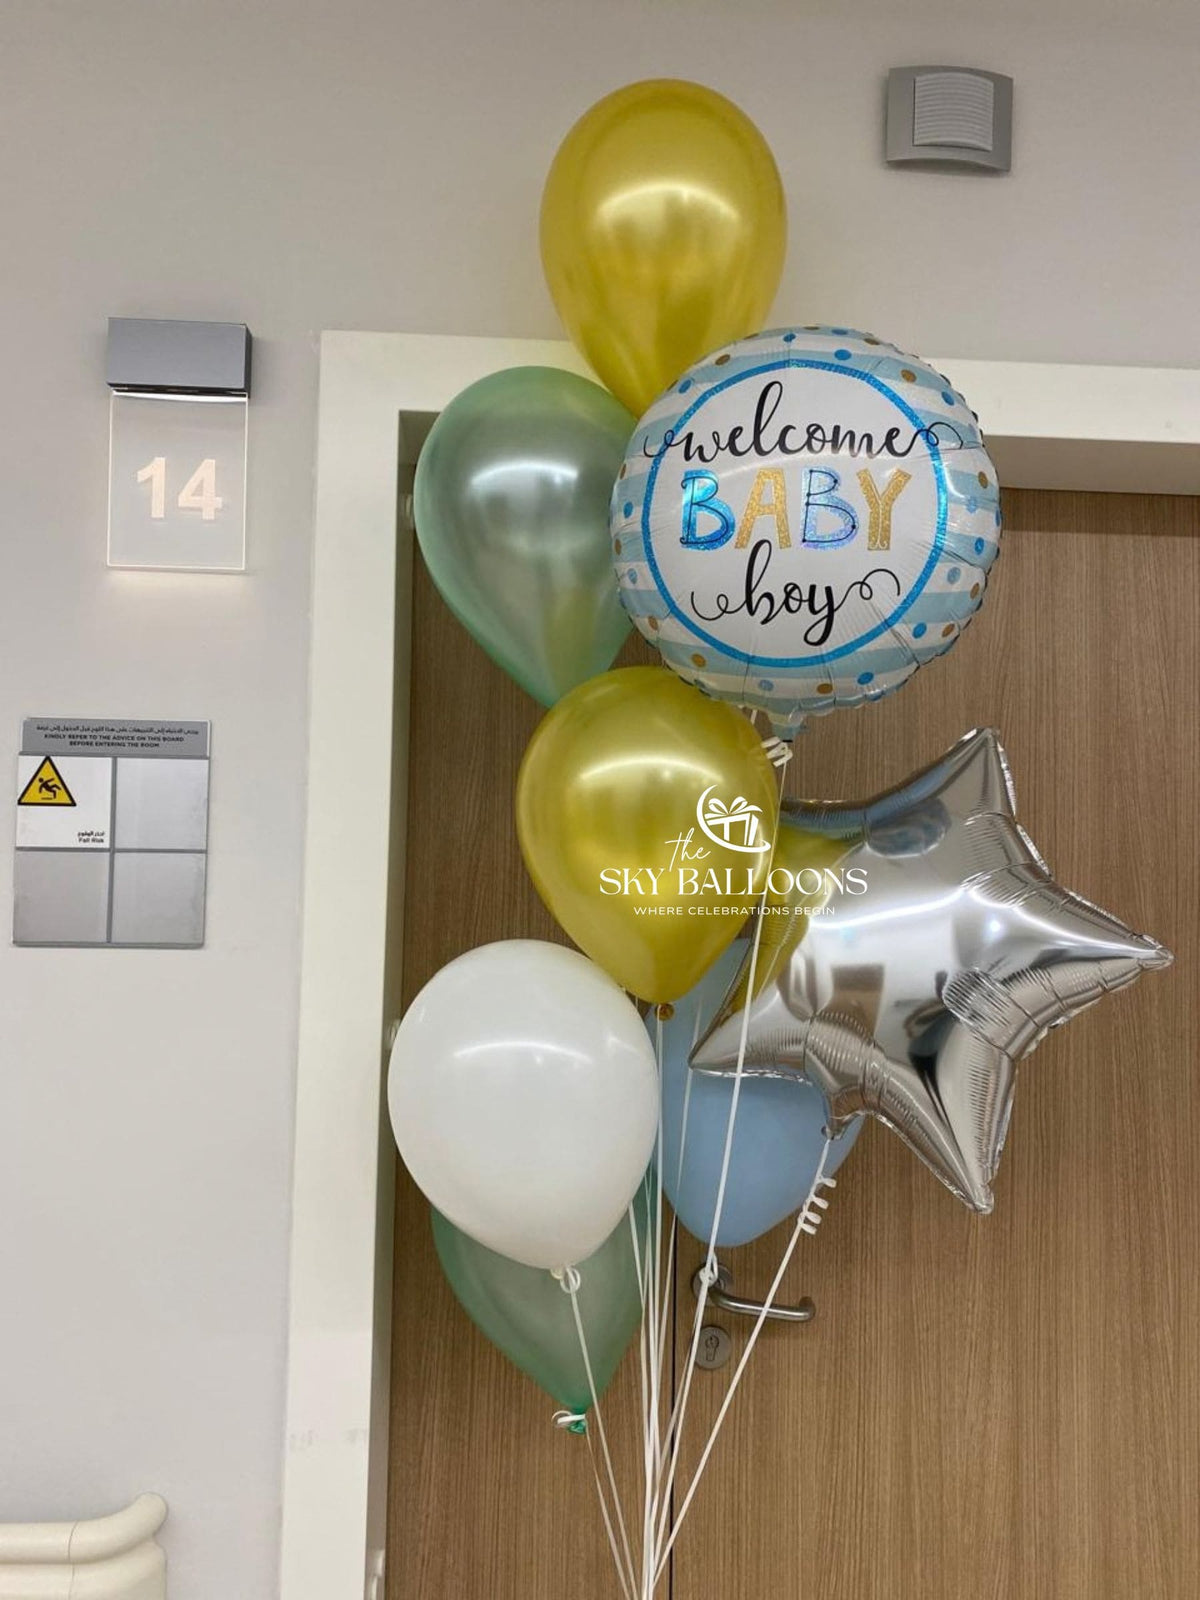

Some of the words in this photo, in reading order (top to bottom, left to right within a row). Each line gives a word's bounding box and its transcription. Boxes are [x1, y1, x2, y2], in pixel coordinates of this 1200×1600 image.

[643, 381, 964, 463] welcome
[137, 457, 223, 520] 14
[680, 465, 912, 551] BABY
[691, 539, 900, 647] boy
